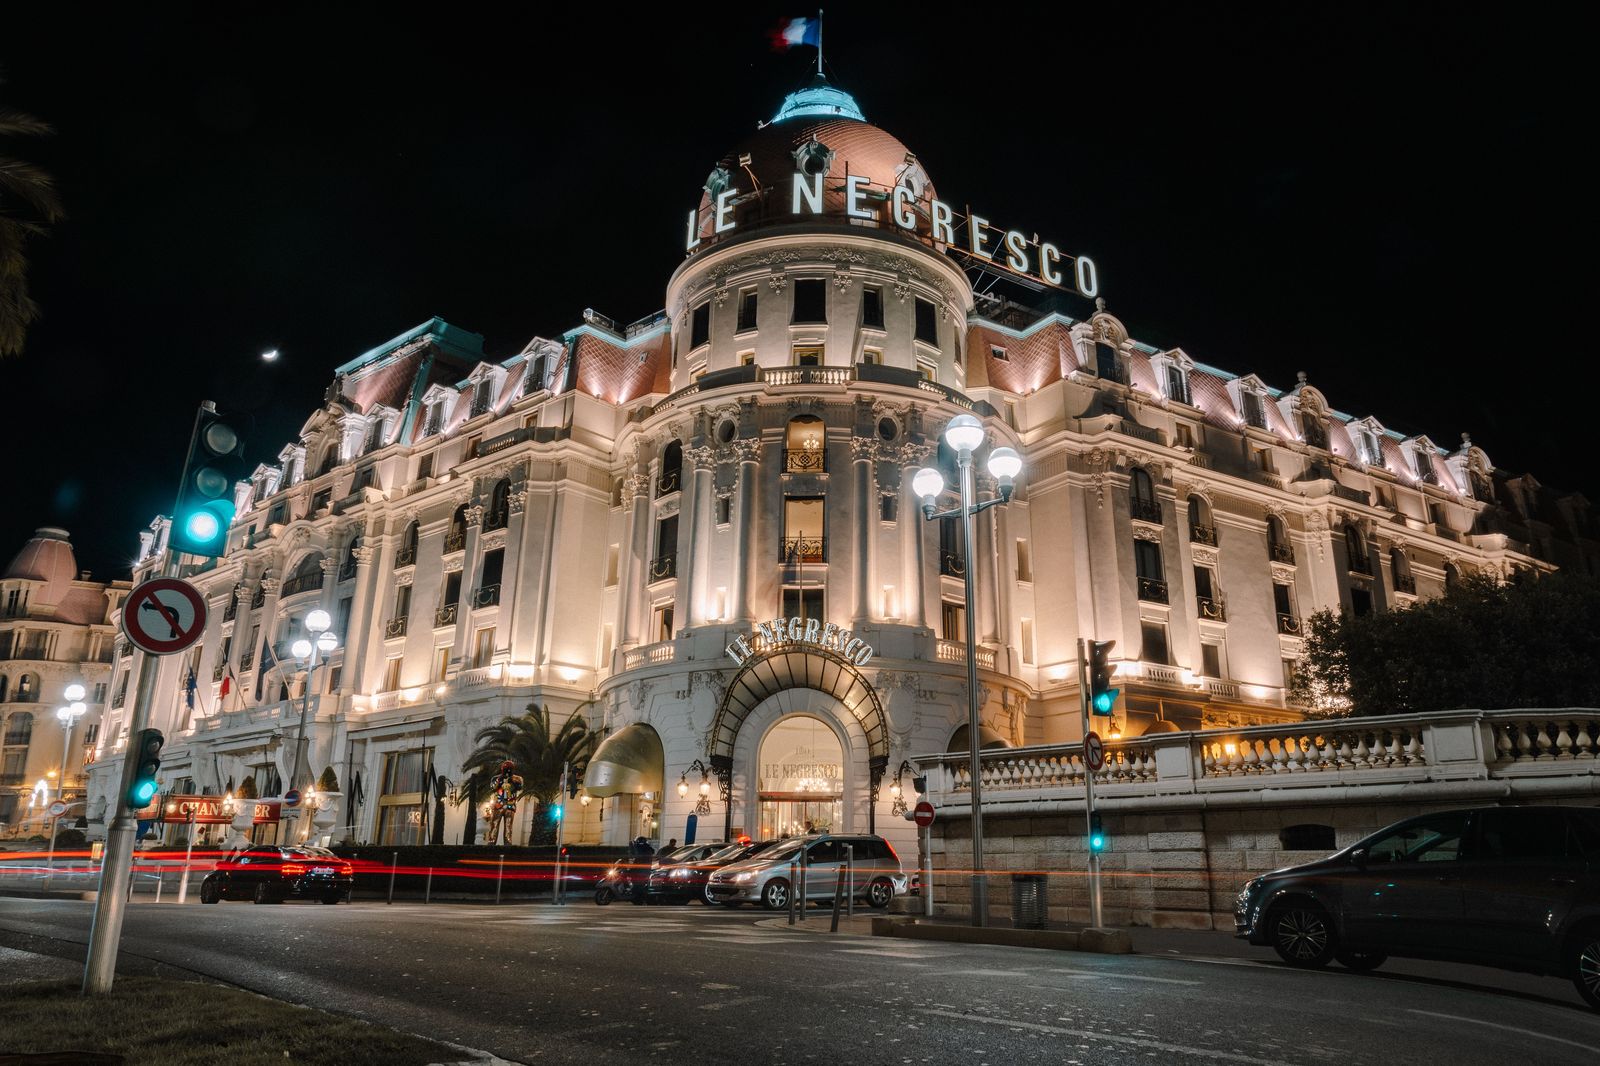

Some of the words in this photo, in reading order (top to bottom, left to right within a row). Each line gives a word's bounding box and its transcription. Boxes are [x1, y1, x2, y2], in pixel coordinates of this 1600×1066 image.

[686, 187, 739, 251] LE
[791, 172, 1099, 299] NEGRESCO
[725, 634, 755, 666] LE
[758, 616, 873, 666] NEGRESCO
[765, 763, 779, 778] LE
[782, 763, 838, 779] NEGRESCO
